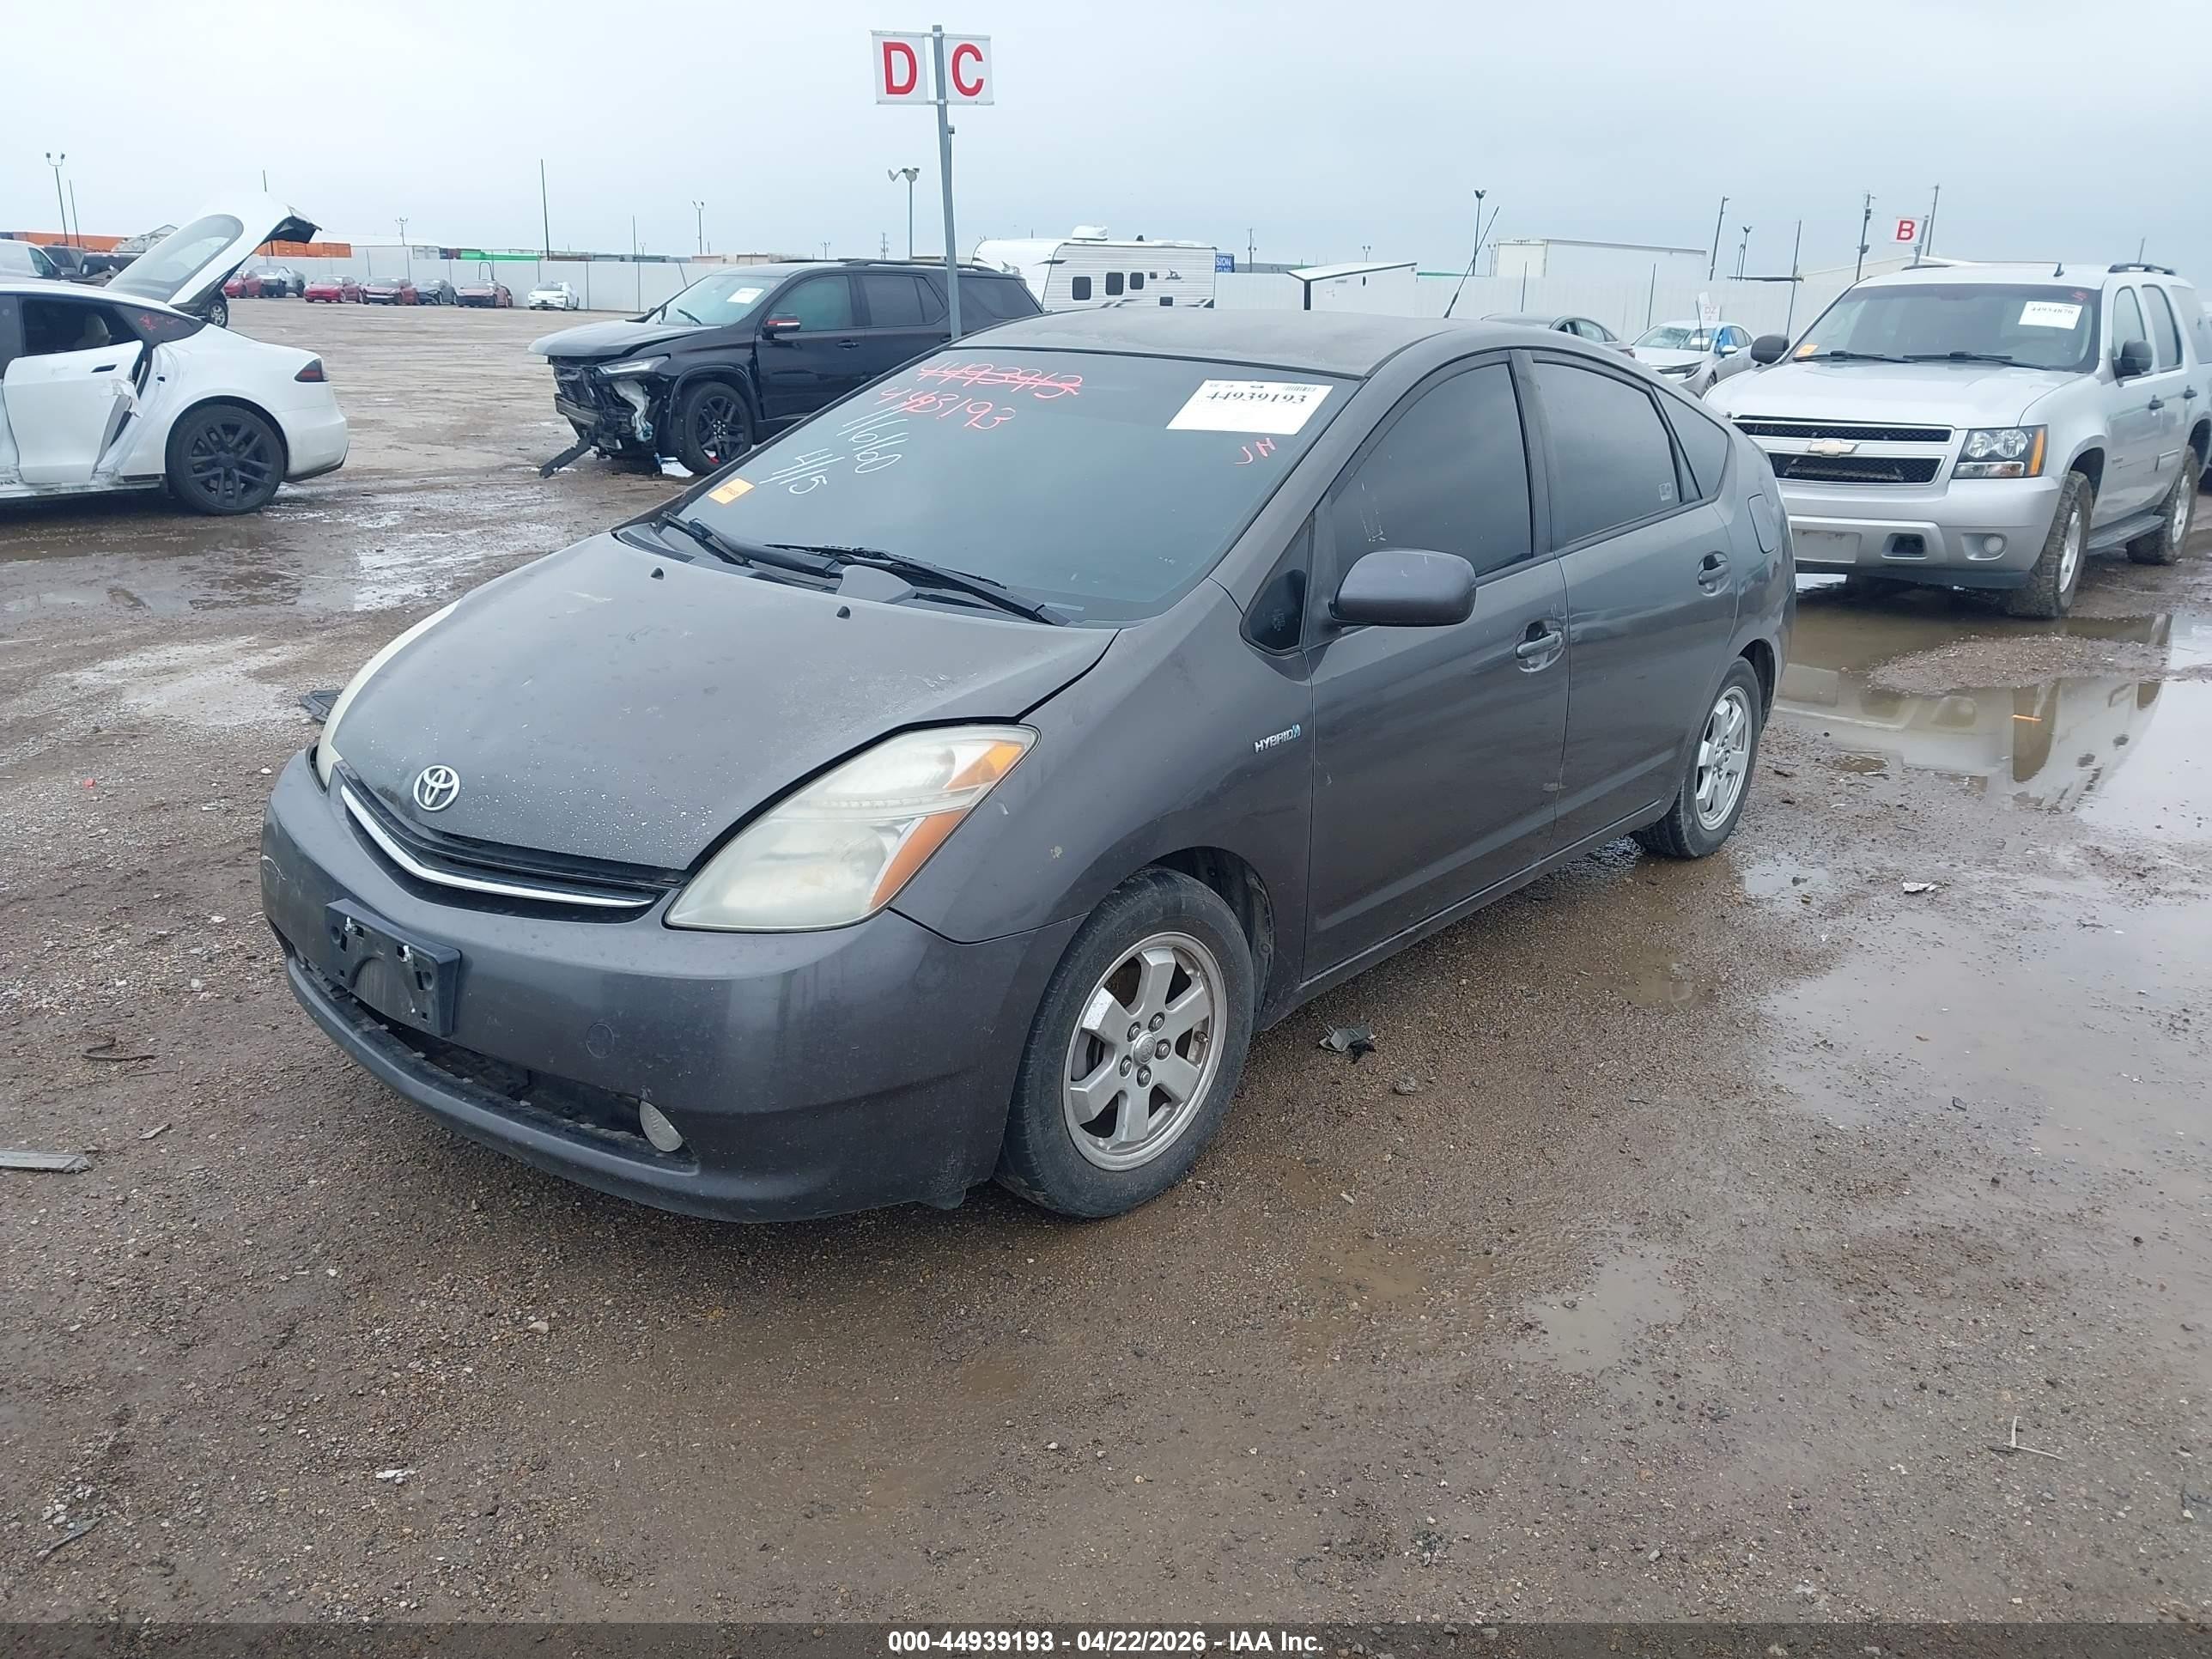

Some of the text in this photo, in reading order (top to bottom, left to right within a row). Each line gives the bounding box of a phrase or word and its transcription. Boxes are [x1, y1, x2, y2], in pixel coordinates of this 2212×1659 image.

[883, 41, 917, 94] D
[951, 43, 984, 96] C
[1896, 220, 1916, 240] B
[1206, 391, 1307, 404] 44939193
[1254, 728, 1293, 754] HYBRID
